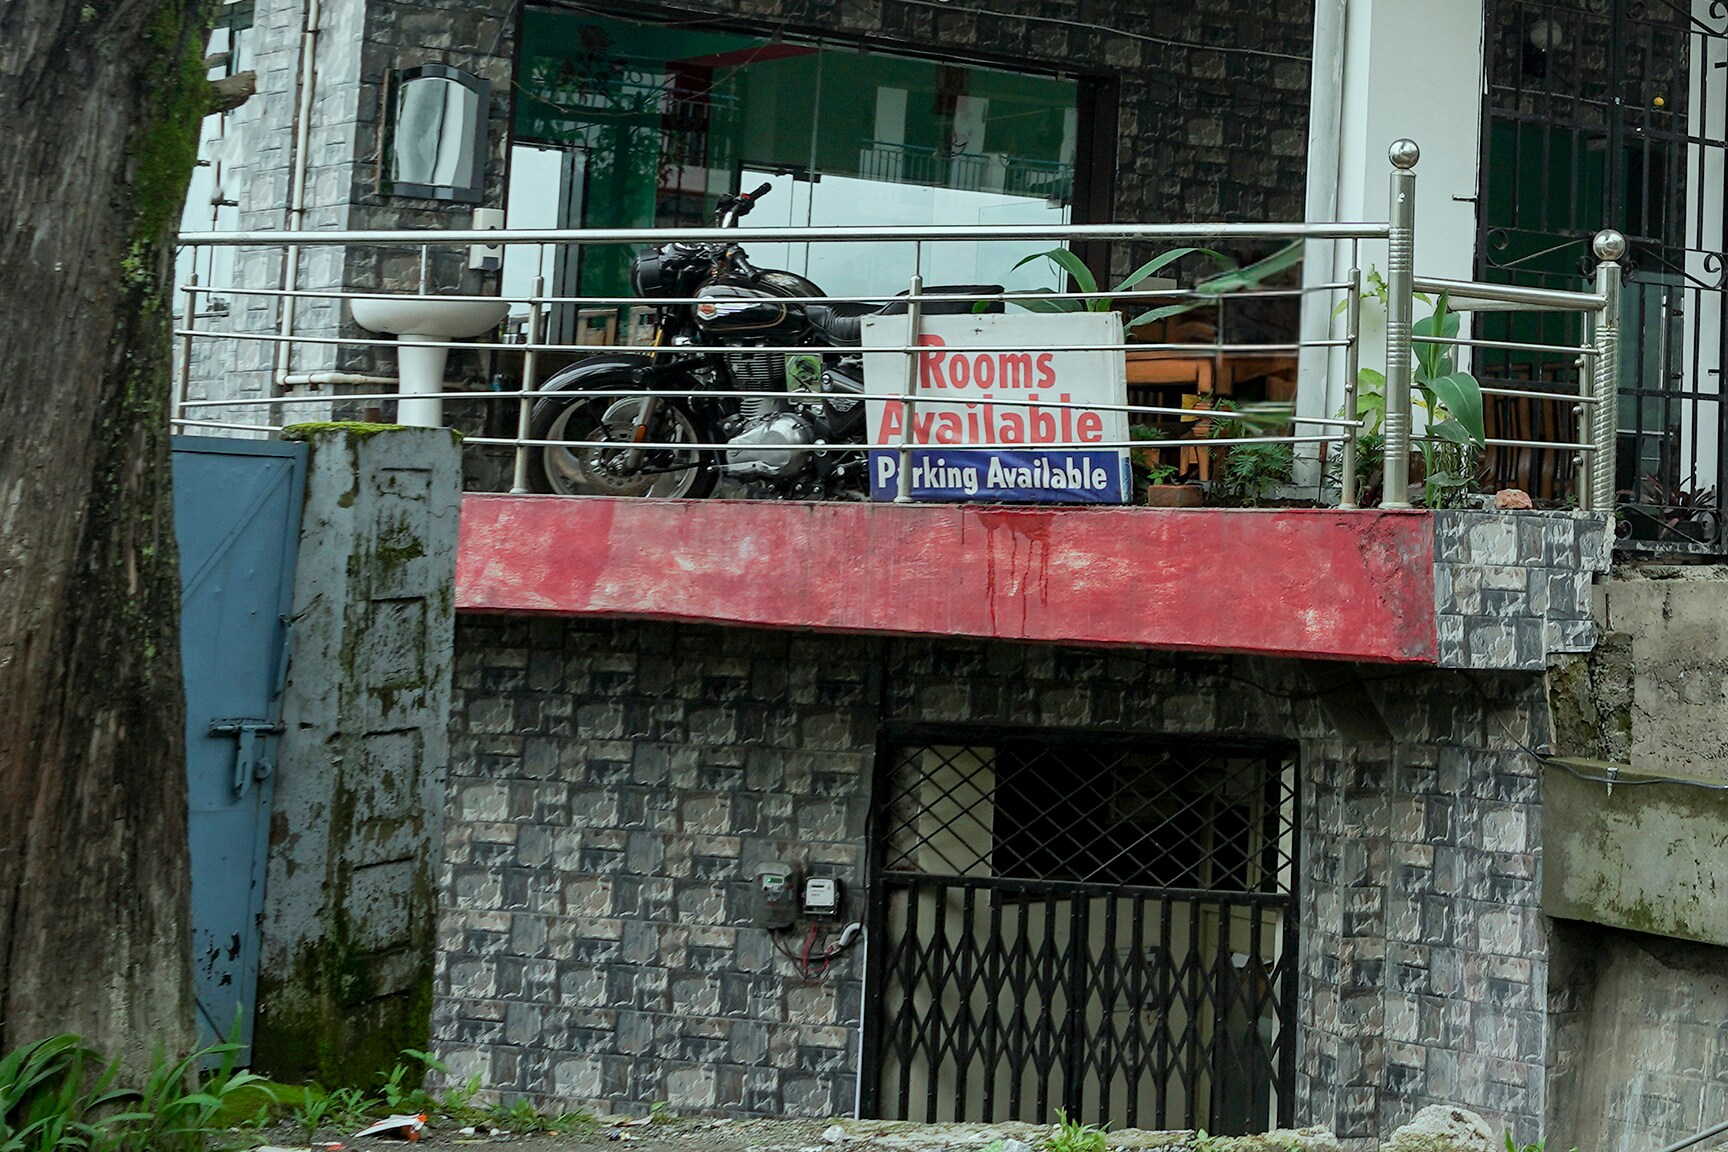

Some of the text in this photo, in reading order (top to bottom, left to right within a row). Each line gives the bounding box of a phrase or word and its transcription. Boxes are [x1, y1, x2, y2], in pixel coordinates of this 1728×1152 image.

[919, 334, 1056, 389] Rooms
[877, 393, 1103, 444] Available
[877, 456, 1108, 495] Prking Available
